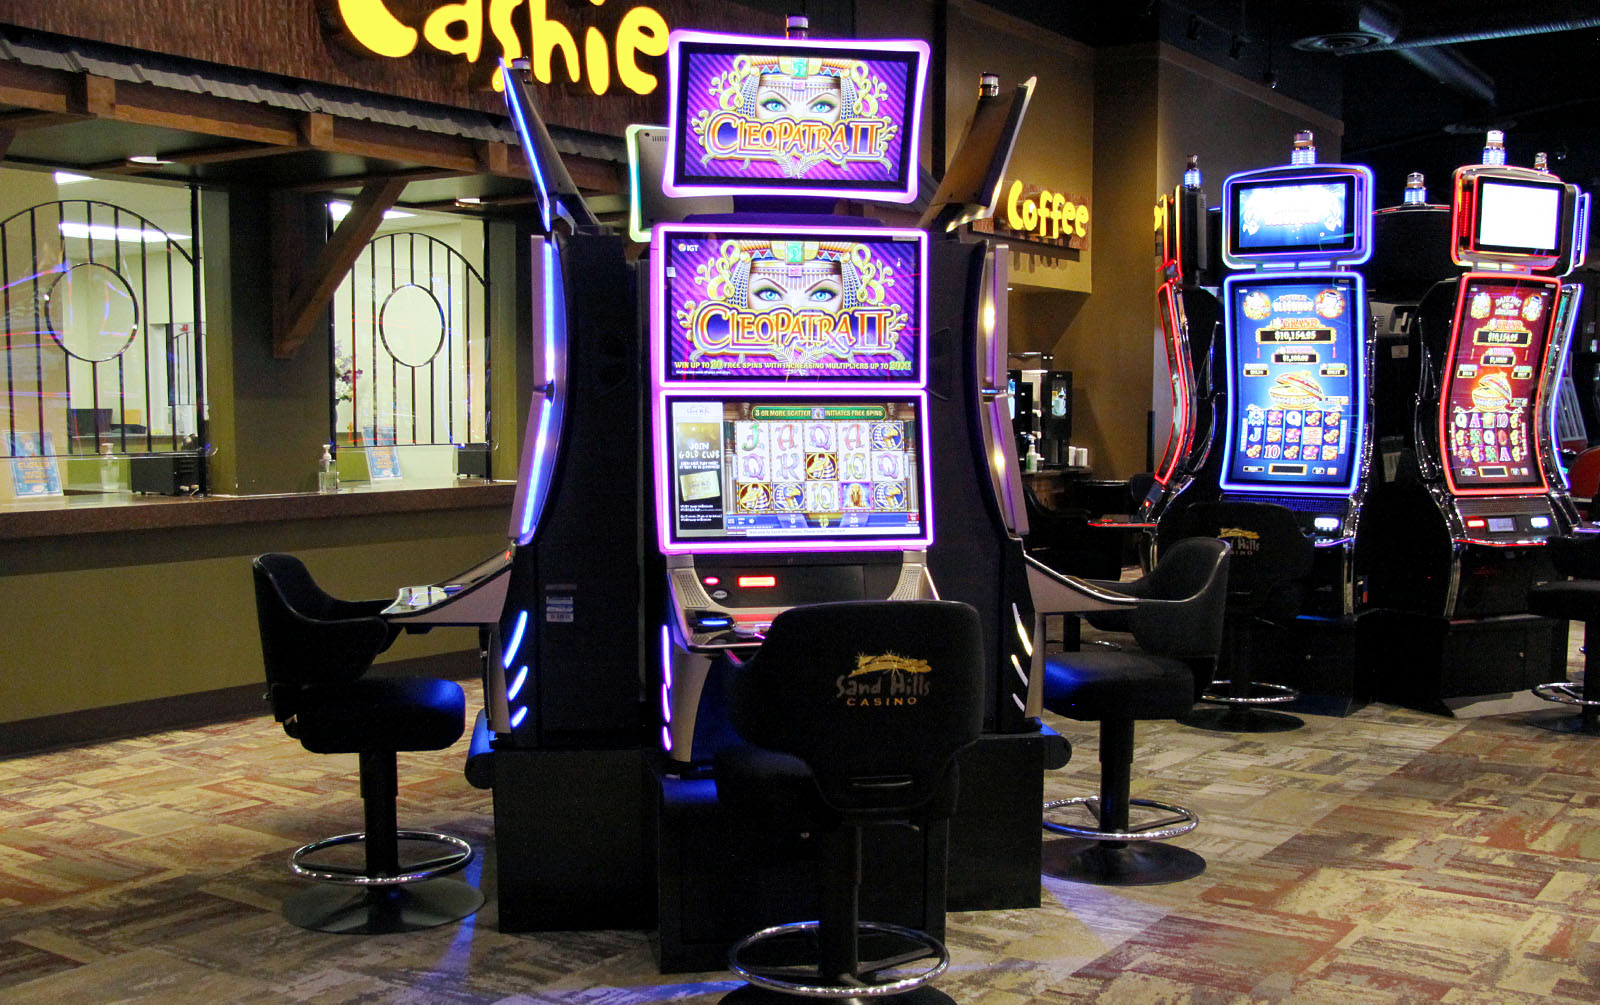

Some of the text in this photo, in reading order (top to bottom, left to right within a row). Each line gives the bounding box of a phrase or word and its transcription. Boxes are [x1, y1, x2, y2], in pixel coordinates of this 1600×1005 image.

[709, 115, 882, 160] CLEOPATRA II
[1008, 179, 1089, 239] Coffee
[686, 244, 699, 252] IGT
[698, 306, 892, 353] CLEOPATRA II
[674, 361, 690, 369] WIN
[690, 361, 700, 369] UP
[701, 361, 710, 369] TO
[724, 361, 741, 369] FREE
[742, 361, 763, 369] SPINS
[689, 442, 709, 450] JOIN
[1264, 444, 1280, 459] 10
[679, 450, 720, 459] GOLD CLUB
[836, 673, 931, 698] Sand Hills
[846, 697, 918, 706] CASINO
